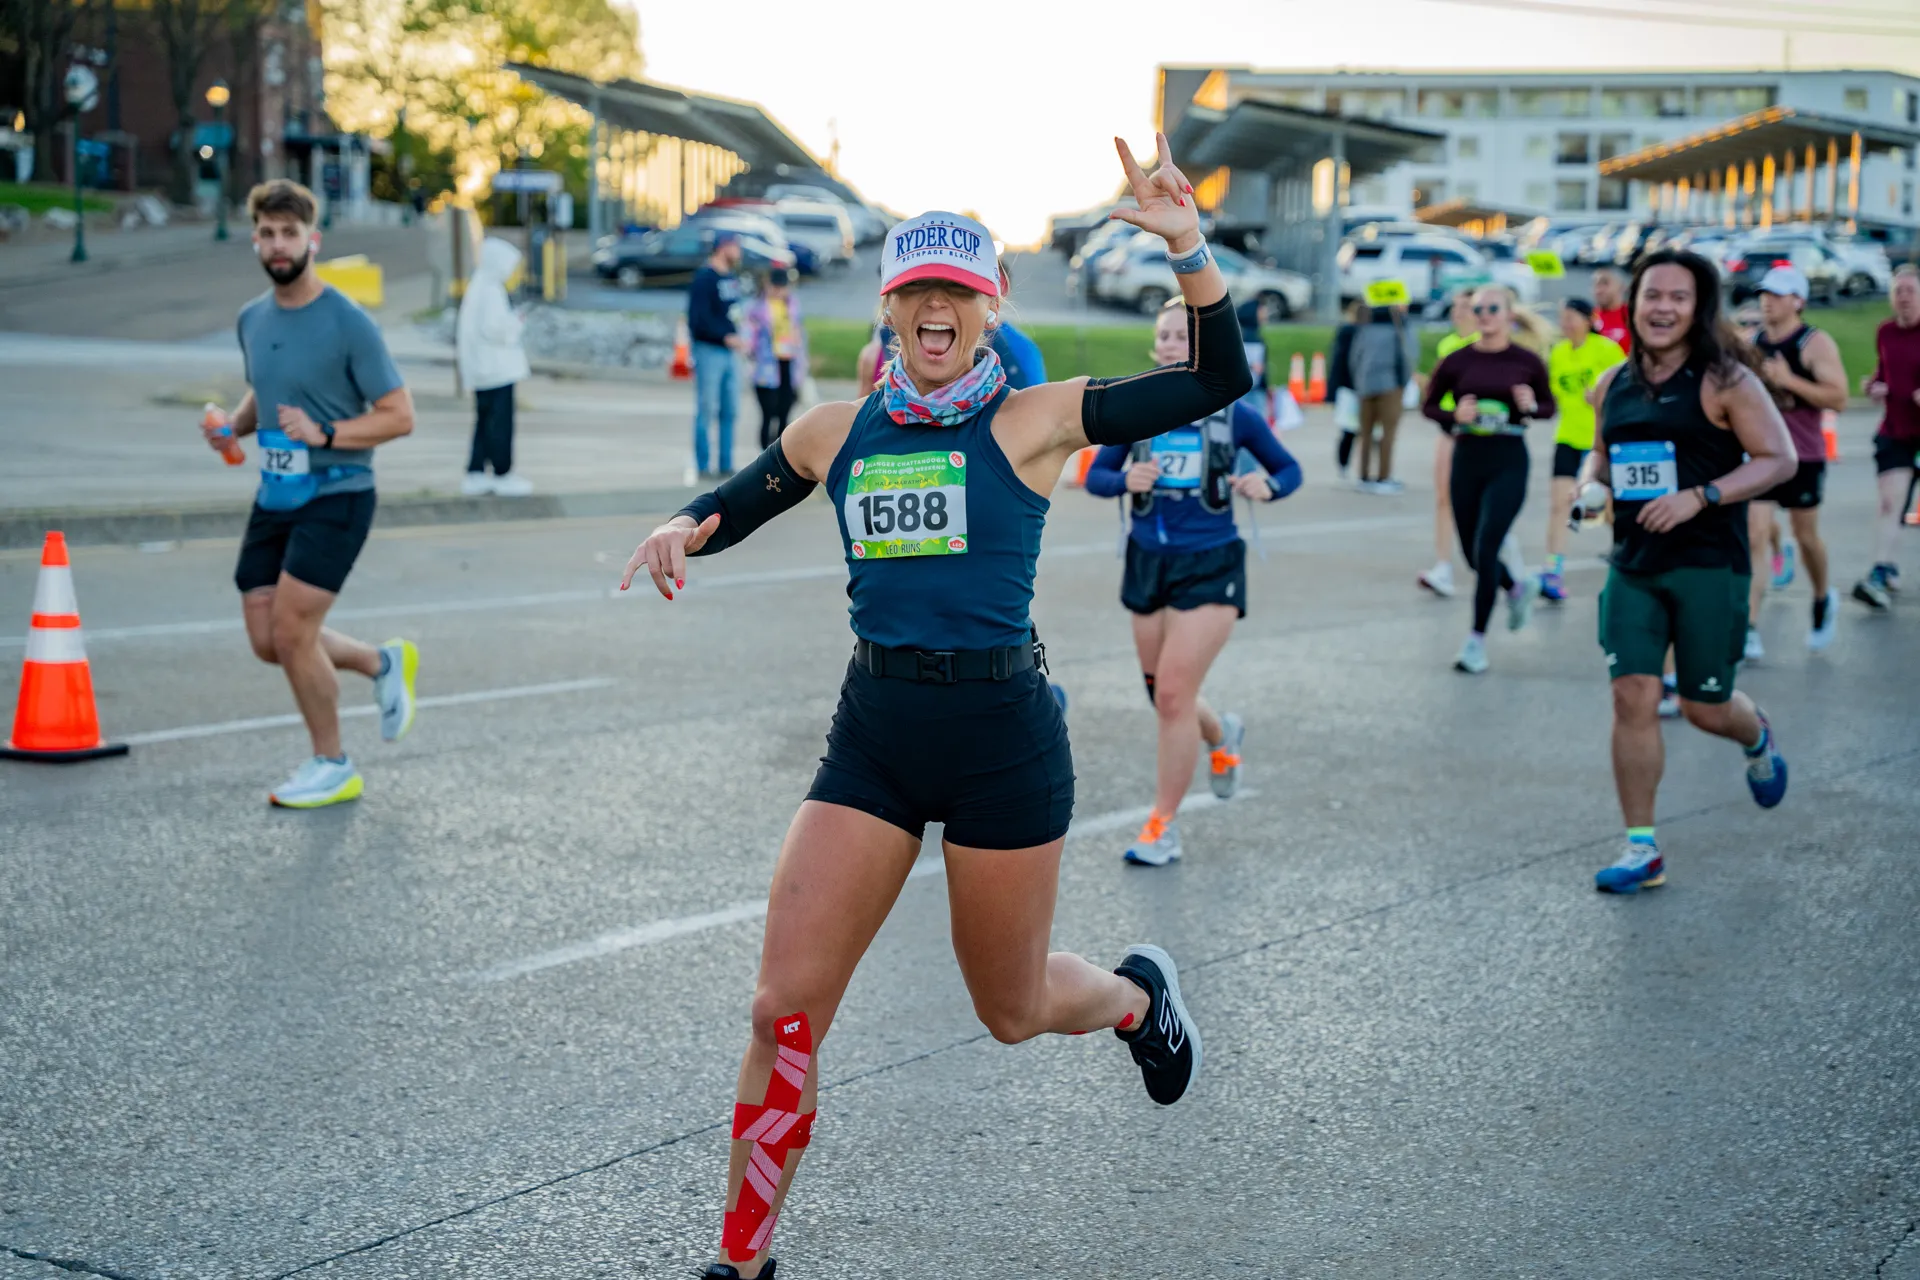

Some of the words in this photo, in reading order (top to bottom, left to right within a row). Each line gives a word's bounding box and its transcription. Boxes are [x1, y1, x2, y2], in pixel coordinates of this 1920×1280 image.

[896, 226, 949, 258] RYDER
[951, 228, 981, 256] CUP
[902, 249, 943, 263] BETHPAGE
[948, 250, 974, 263] BLACK
[897, 458, 946, 467] CHATTANOOGA
[1627, 464, 1660, 486] 315
[858, 491, 949, 536] 1588
[886, 545, 898, 555] LEO
[901, 543, 921, 554] RUNS
[783, 1020, 801, 1034] KT
